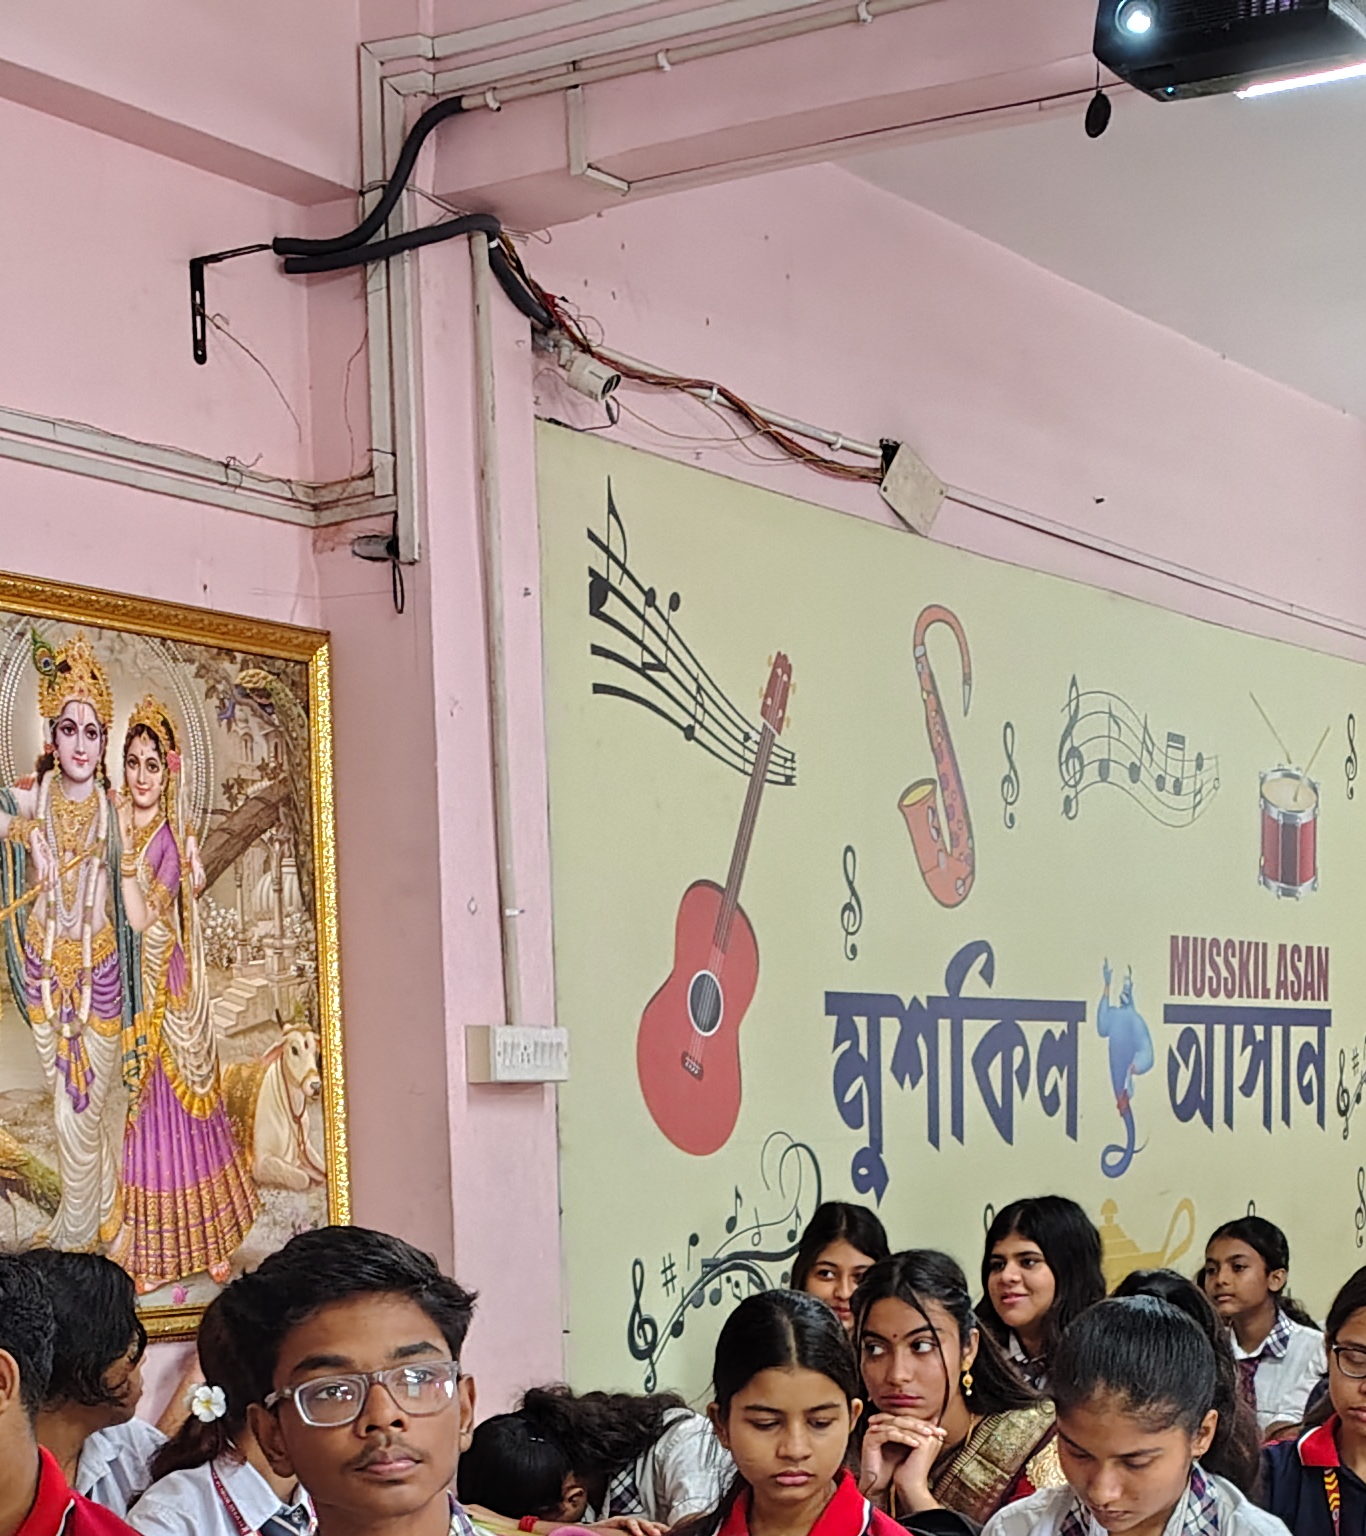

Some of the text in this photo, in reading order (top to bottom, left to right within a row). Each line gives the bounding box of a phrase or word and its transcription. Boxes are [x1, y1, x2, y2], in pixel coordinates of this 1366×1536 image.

[1169, 934, 1330, 1002] MUSSKIL ASAN
[823, 939, 1332, 1207] মুশকিল আসান
